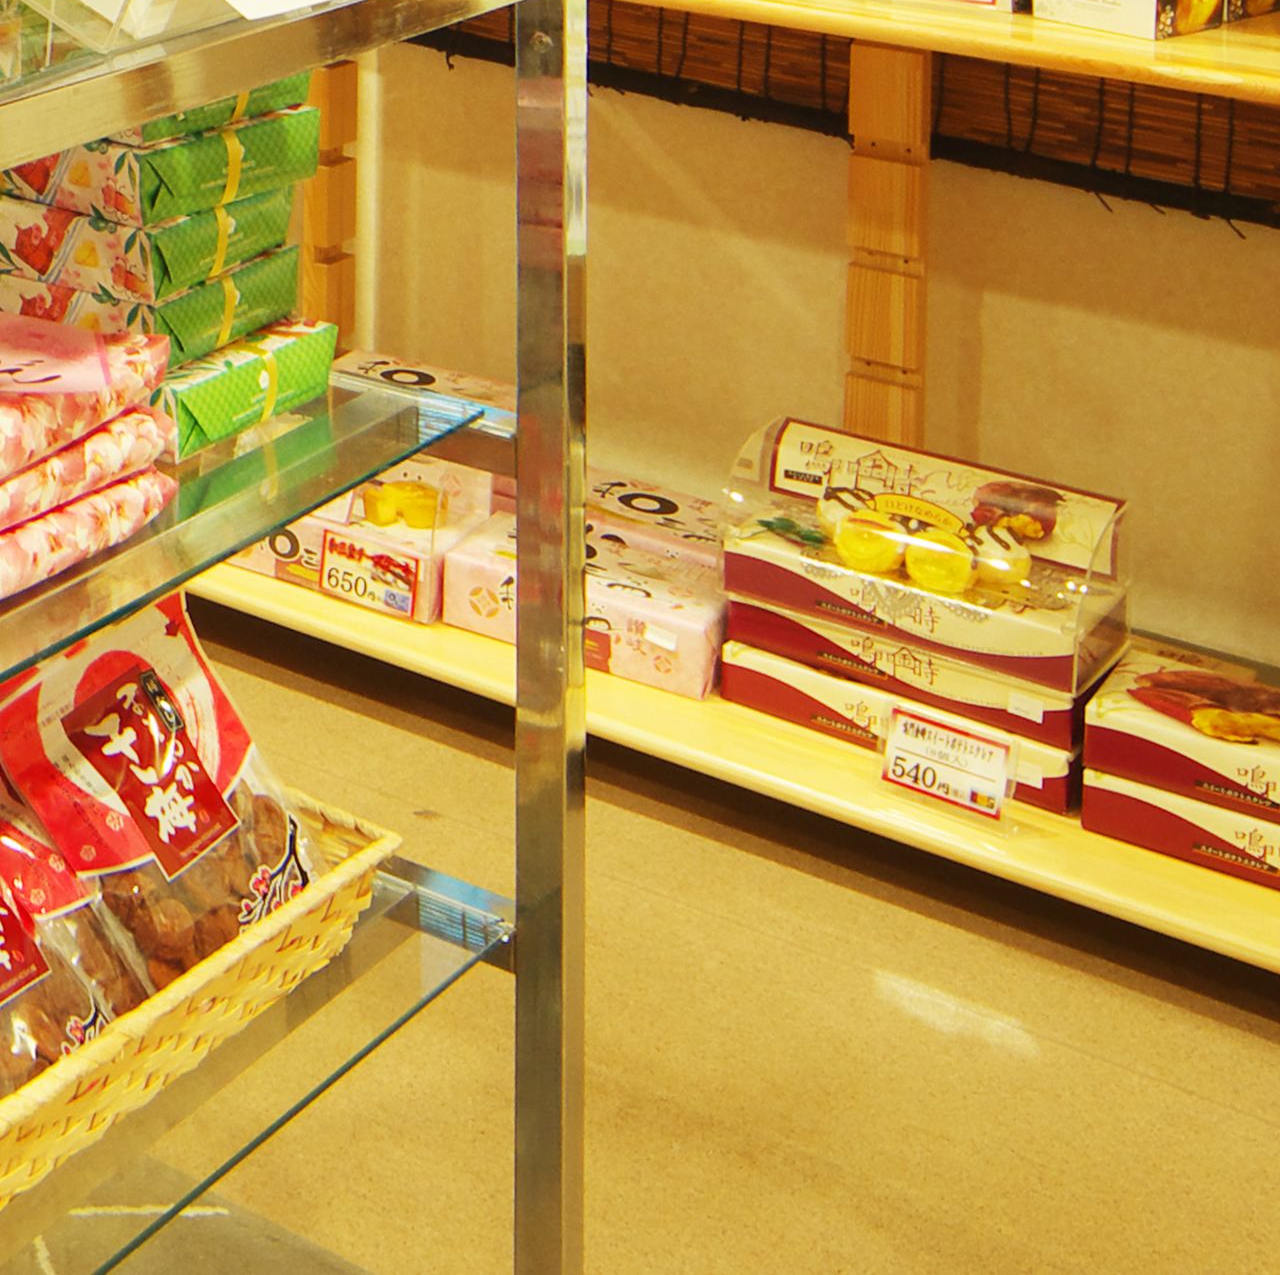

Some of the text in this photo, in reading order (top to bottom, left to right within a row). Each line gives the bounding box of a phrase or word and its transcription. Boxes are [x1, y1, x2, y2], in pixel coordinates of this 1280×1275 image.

[326, 566, 368, 599] 650
[83, 712, 198, 844] 干し梅
[890, 755, 937, 790] 540
